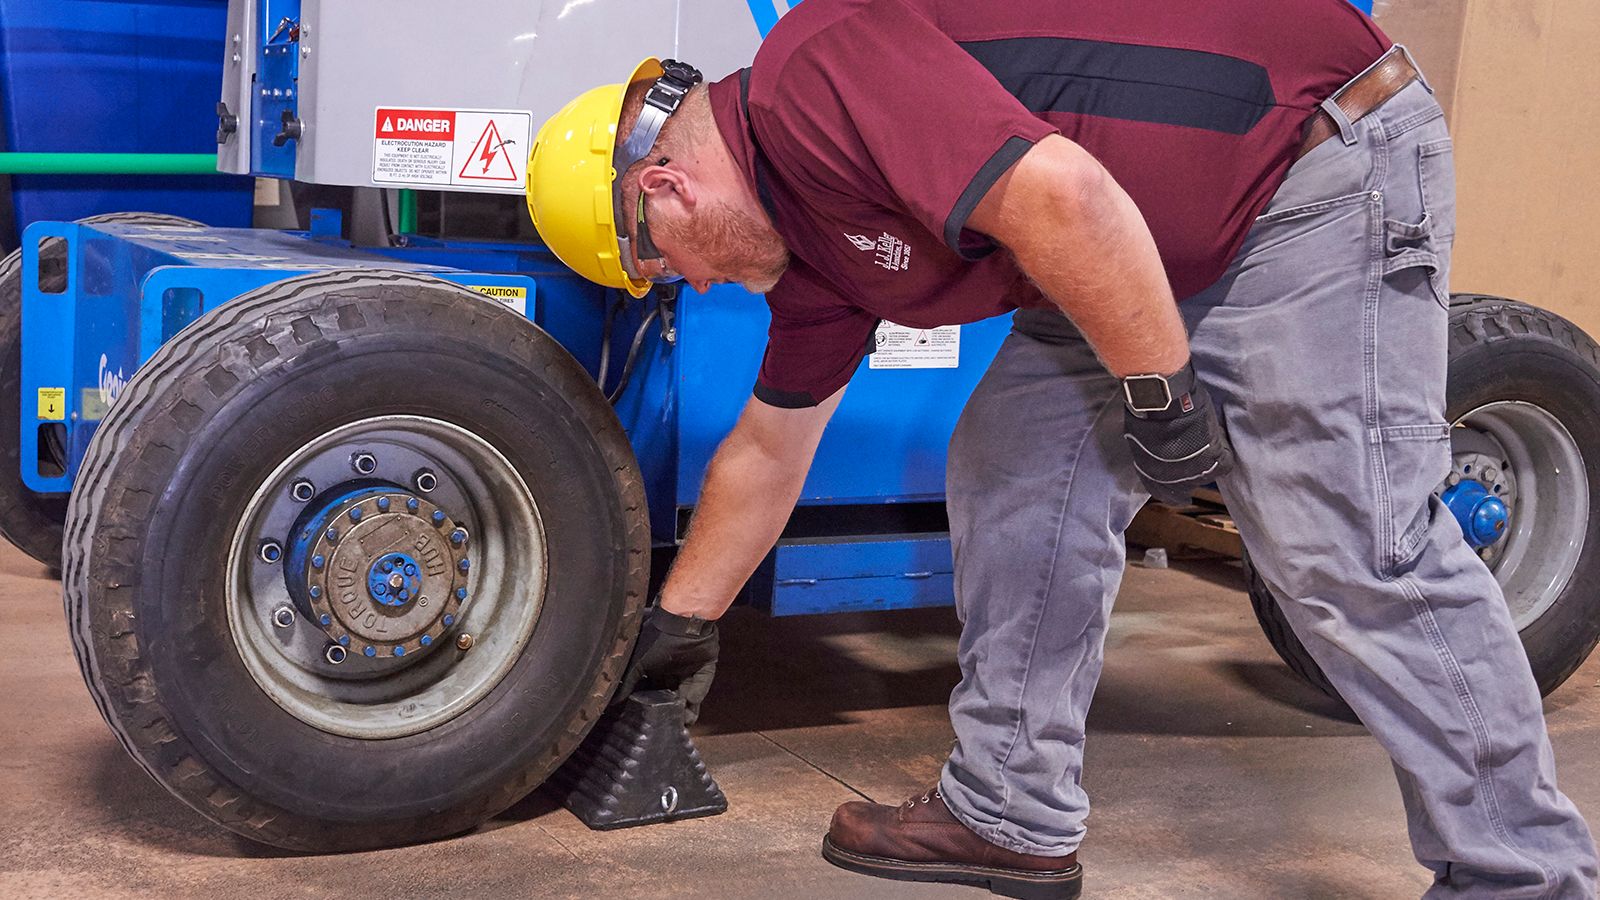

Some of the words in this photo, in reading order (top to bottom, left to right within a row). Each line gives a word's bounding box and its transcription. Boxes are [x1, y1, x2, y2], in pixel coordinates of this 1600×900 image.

[397, 118, 450, 132] DANGER
[877, 232, 893, 253] Keller
[901, 256, 910, 270] Since
[99, 353, 129, 407] Geni
[415, 534, 445, 576] HUB
[338, 556, 388, 633] TORQUE
